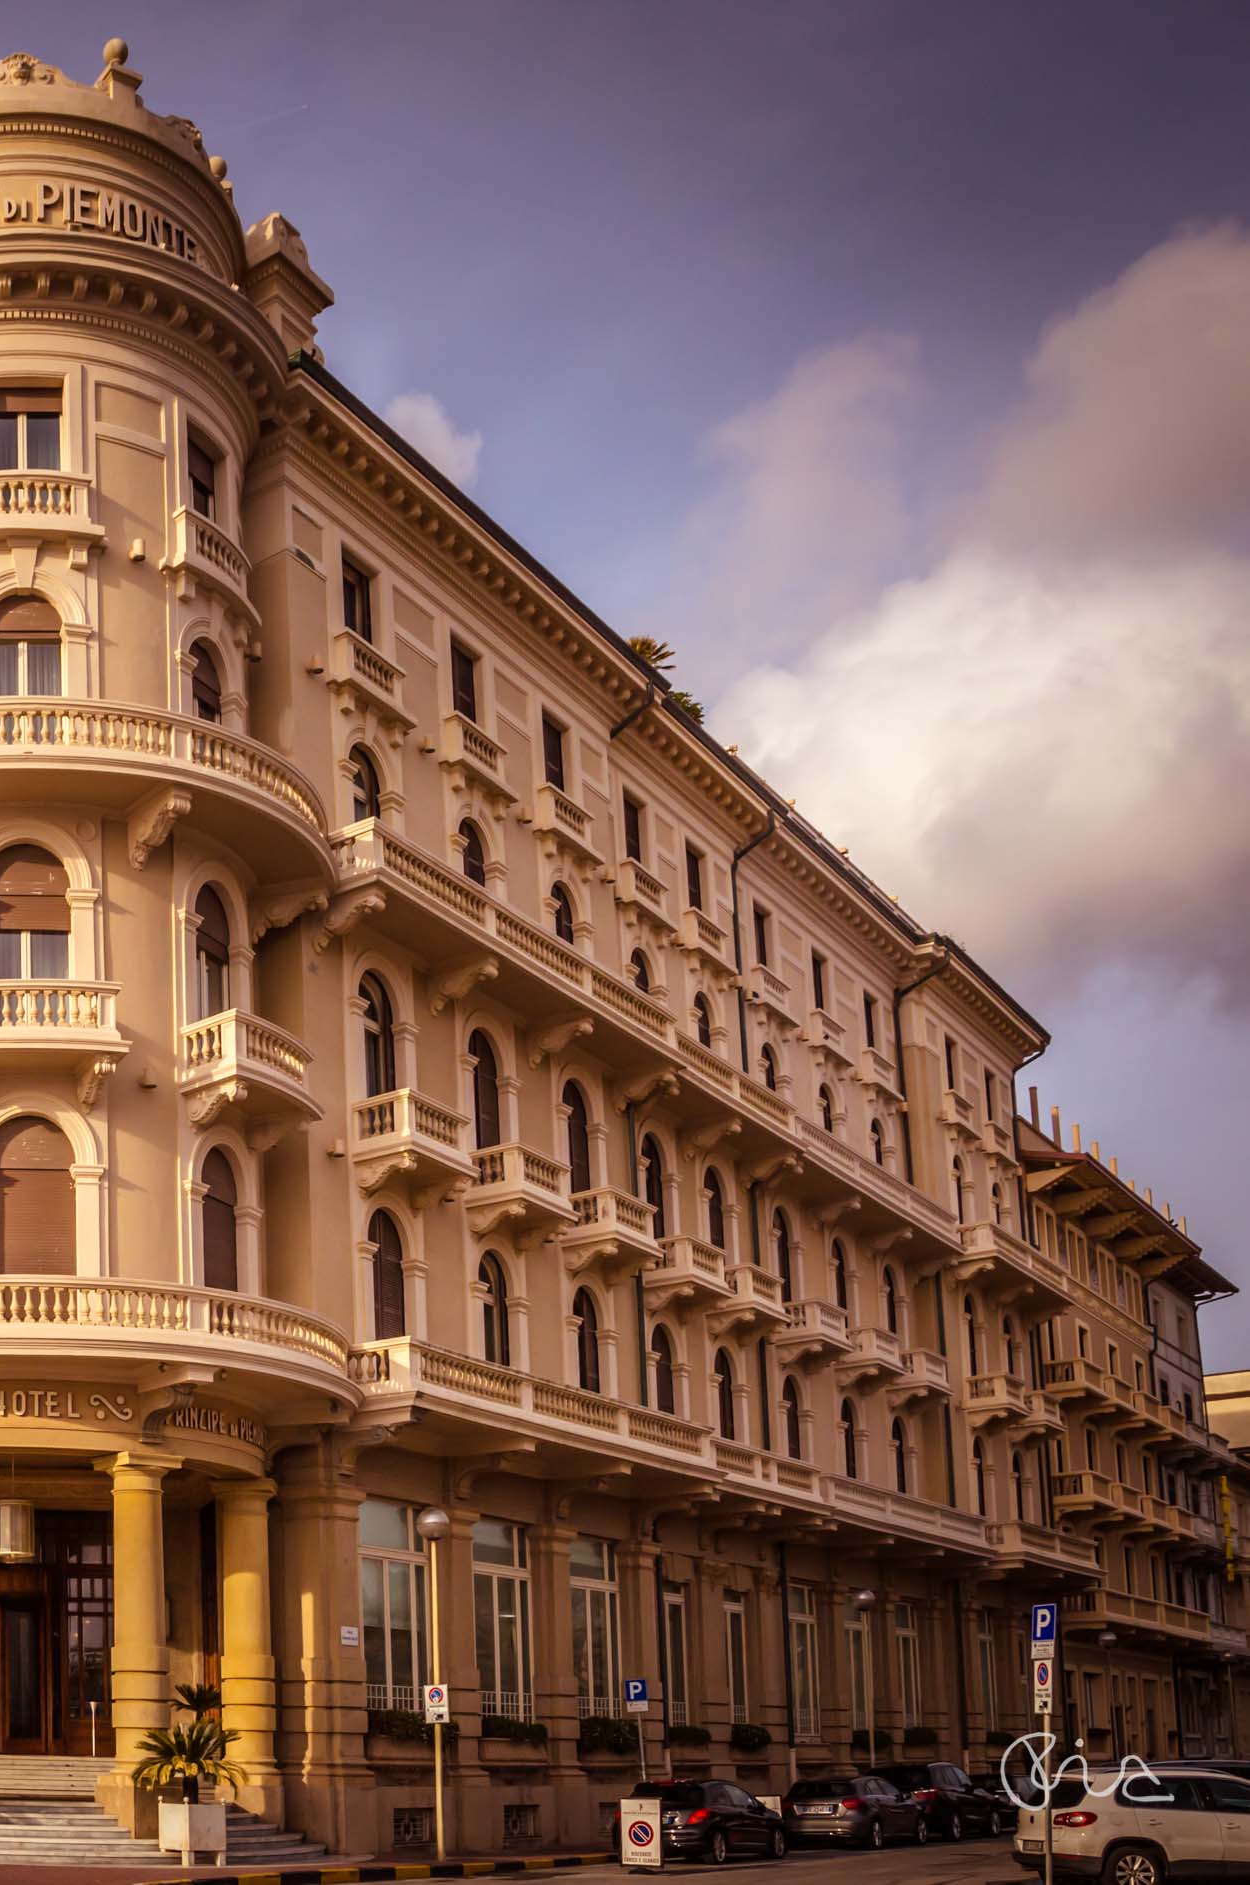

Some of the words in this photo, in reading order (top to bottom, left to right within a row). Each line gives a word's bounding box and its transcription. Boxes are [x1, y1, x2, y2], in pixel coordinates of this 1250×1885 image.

[3, 197, 29, 223] DI
[36, 183, 197, 264] PIEMONTE
[1036, 1608, 1051, 1638] P
[629, 1681, 643, 1700] P
